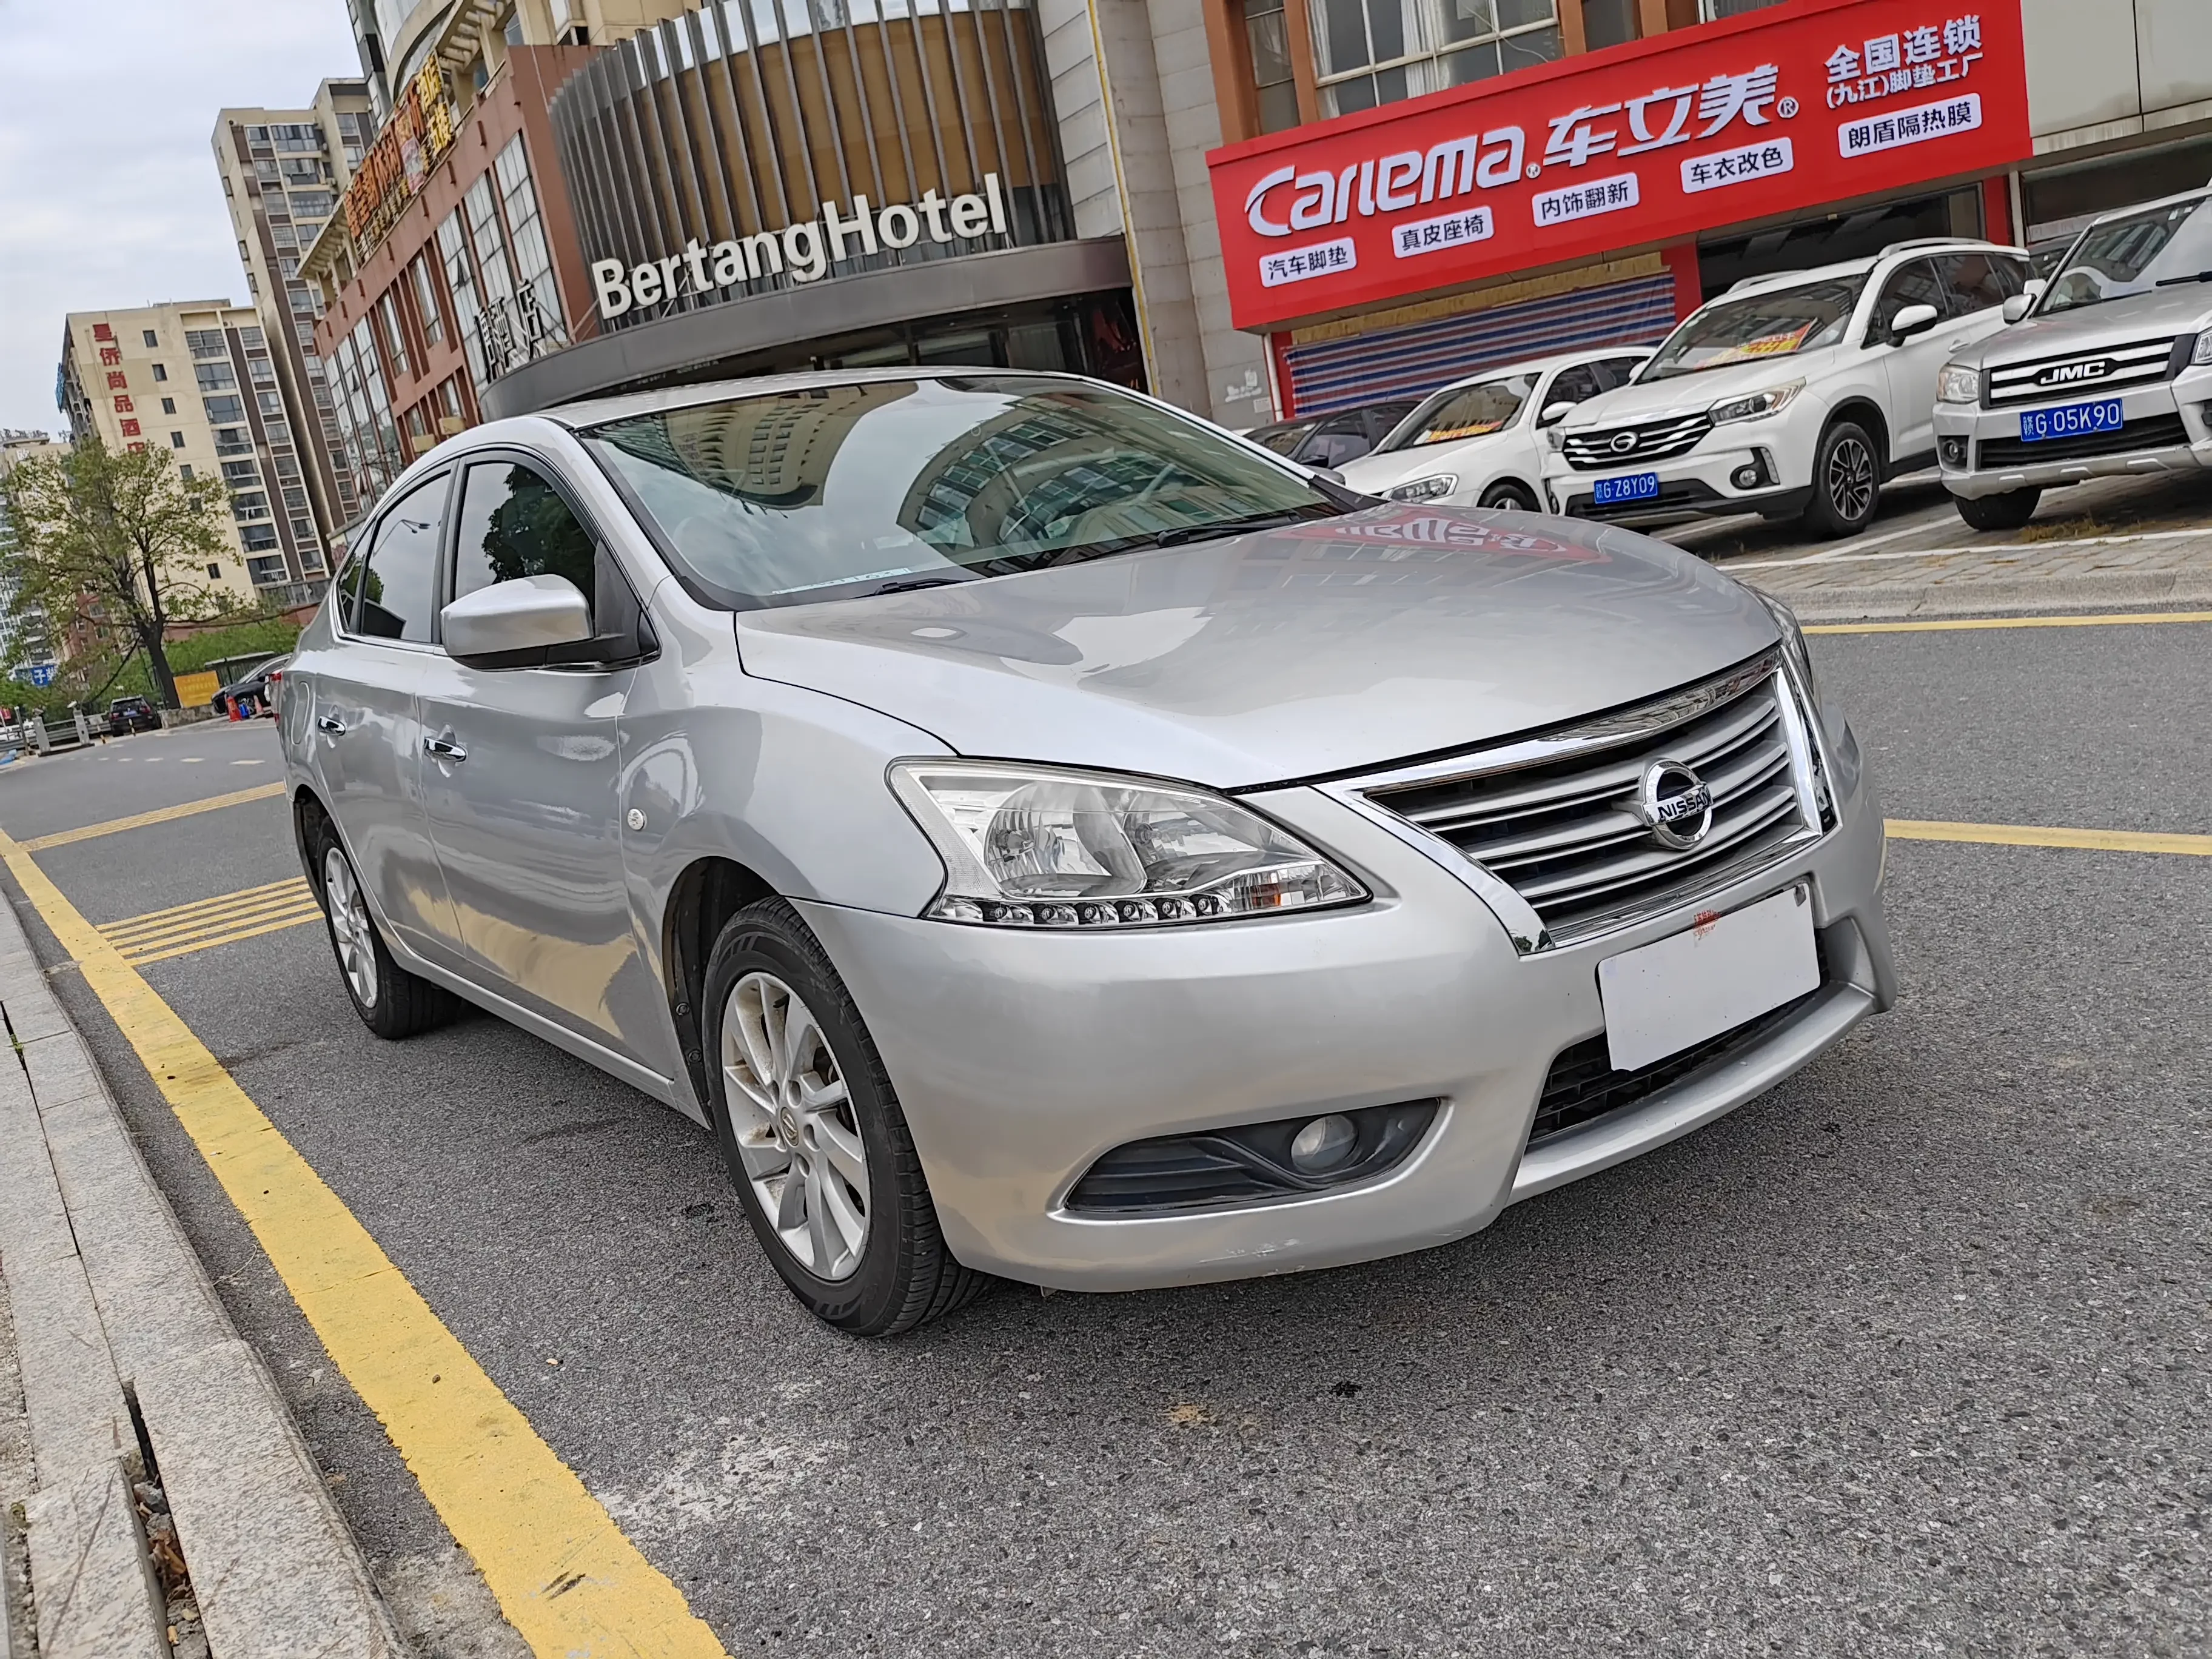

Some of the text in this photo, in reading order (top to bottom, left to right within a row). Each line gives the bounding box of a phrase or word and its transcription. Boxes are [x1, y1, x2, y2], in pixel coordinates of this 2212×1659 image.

[1824, 14, 1982, 83] 全国连锁
[1826, 52, 1983, 109] (九江)脚垫工厂
[1848, 101, 1972, 150] 朗盾隔热膜
[1690, 146, 1784, 185] 车衣改色
[1541, 179, 1629, 220] 内饰翻新
[1400, 212, 1485, 252] 真皮座椅
[1267, 247, 1349, 280] 汽车脚垫
[2040, 361, 2105, 384] JMC
[1657, 793, 1711, 819] NISSAN
